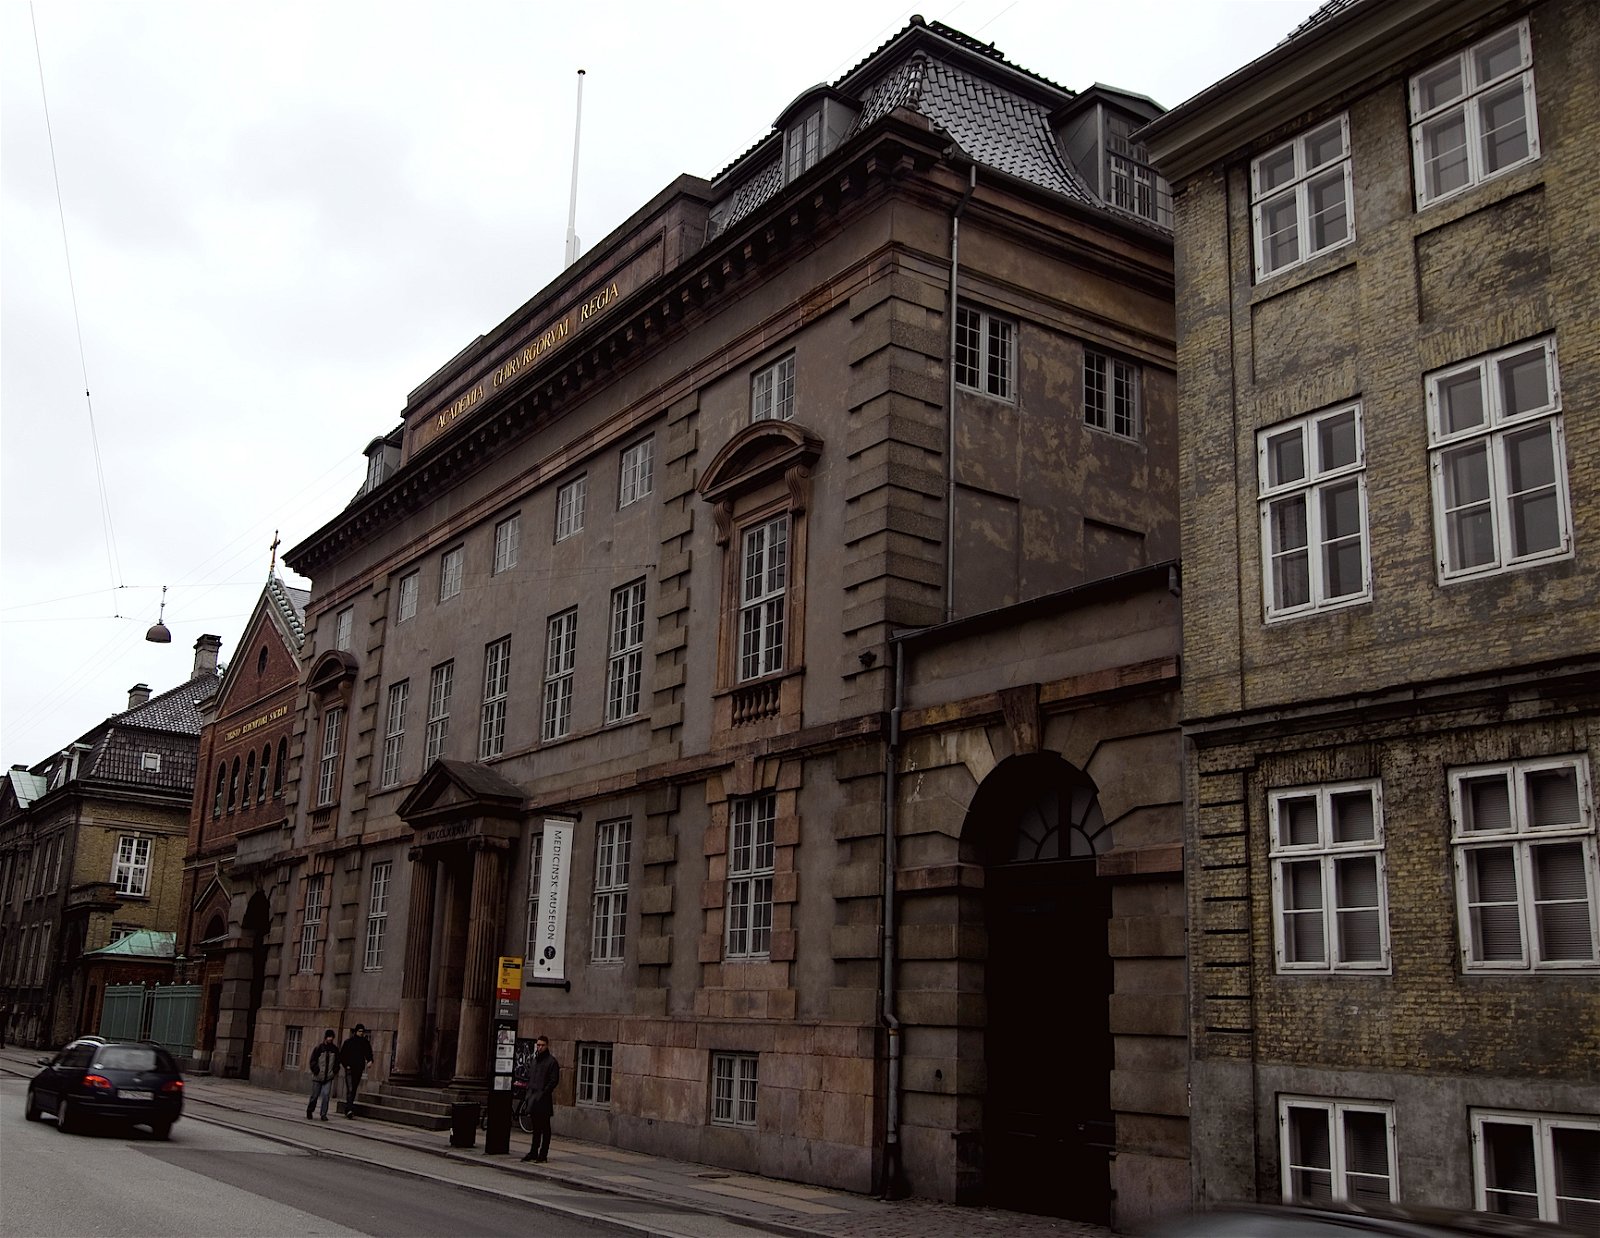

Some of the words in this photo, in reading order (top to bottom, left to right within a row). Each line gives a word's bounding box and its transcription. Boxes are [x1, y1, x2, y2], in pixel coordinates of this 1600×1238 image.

[436, 384, 485, 431] ACADEMIA
[493, 318, 569, 388] CHIRVRGORVM
[580, 282, 619, 323] REGIA
[550, 830, 562, 887] MEDICINSK
[547, 891, 558, 940] MUSEION
